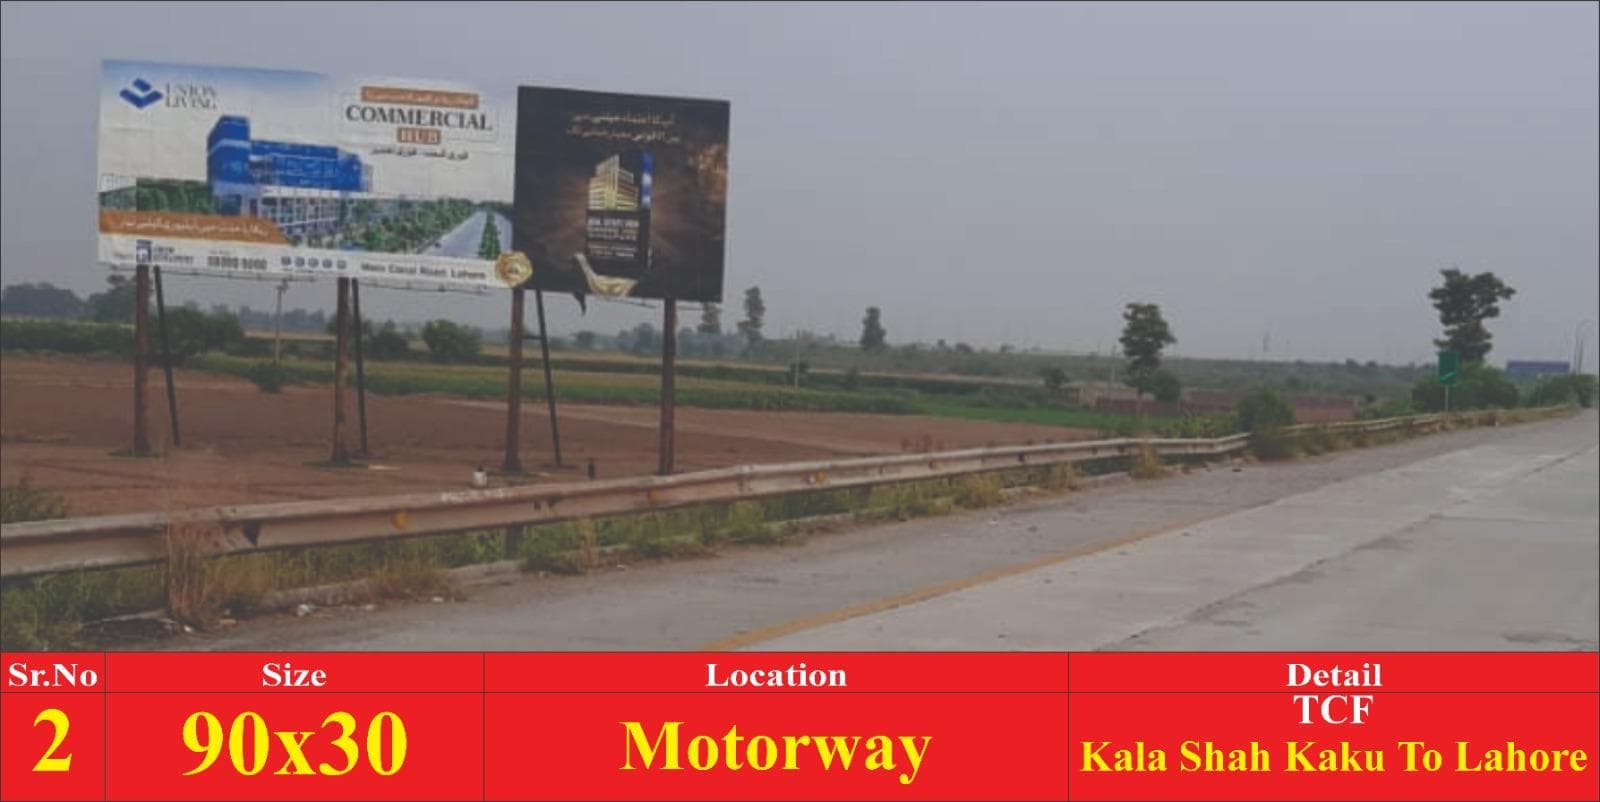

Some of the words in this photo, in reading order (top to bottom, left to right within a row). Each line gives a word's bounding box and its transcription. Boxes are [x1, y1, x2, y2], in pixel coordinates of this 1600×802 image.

[165, 95, 217, 109] LIVING
[345, 104, 493, 131] COMMERCIAL
[399, 127, 440, 144] HUB
